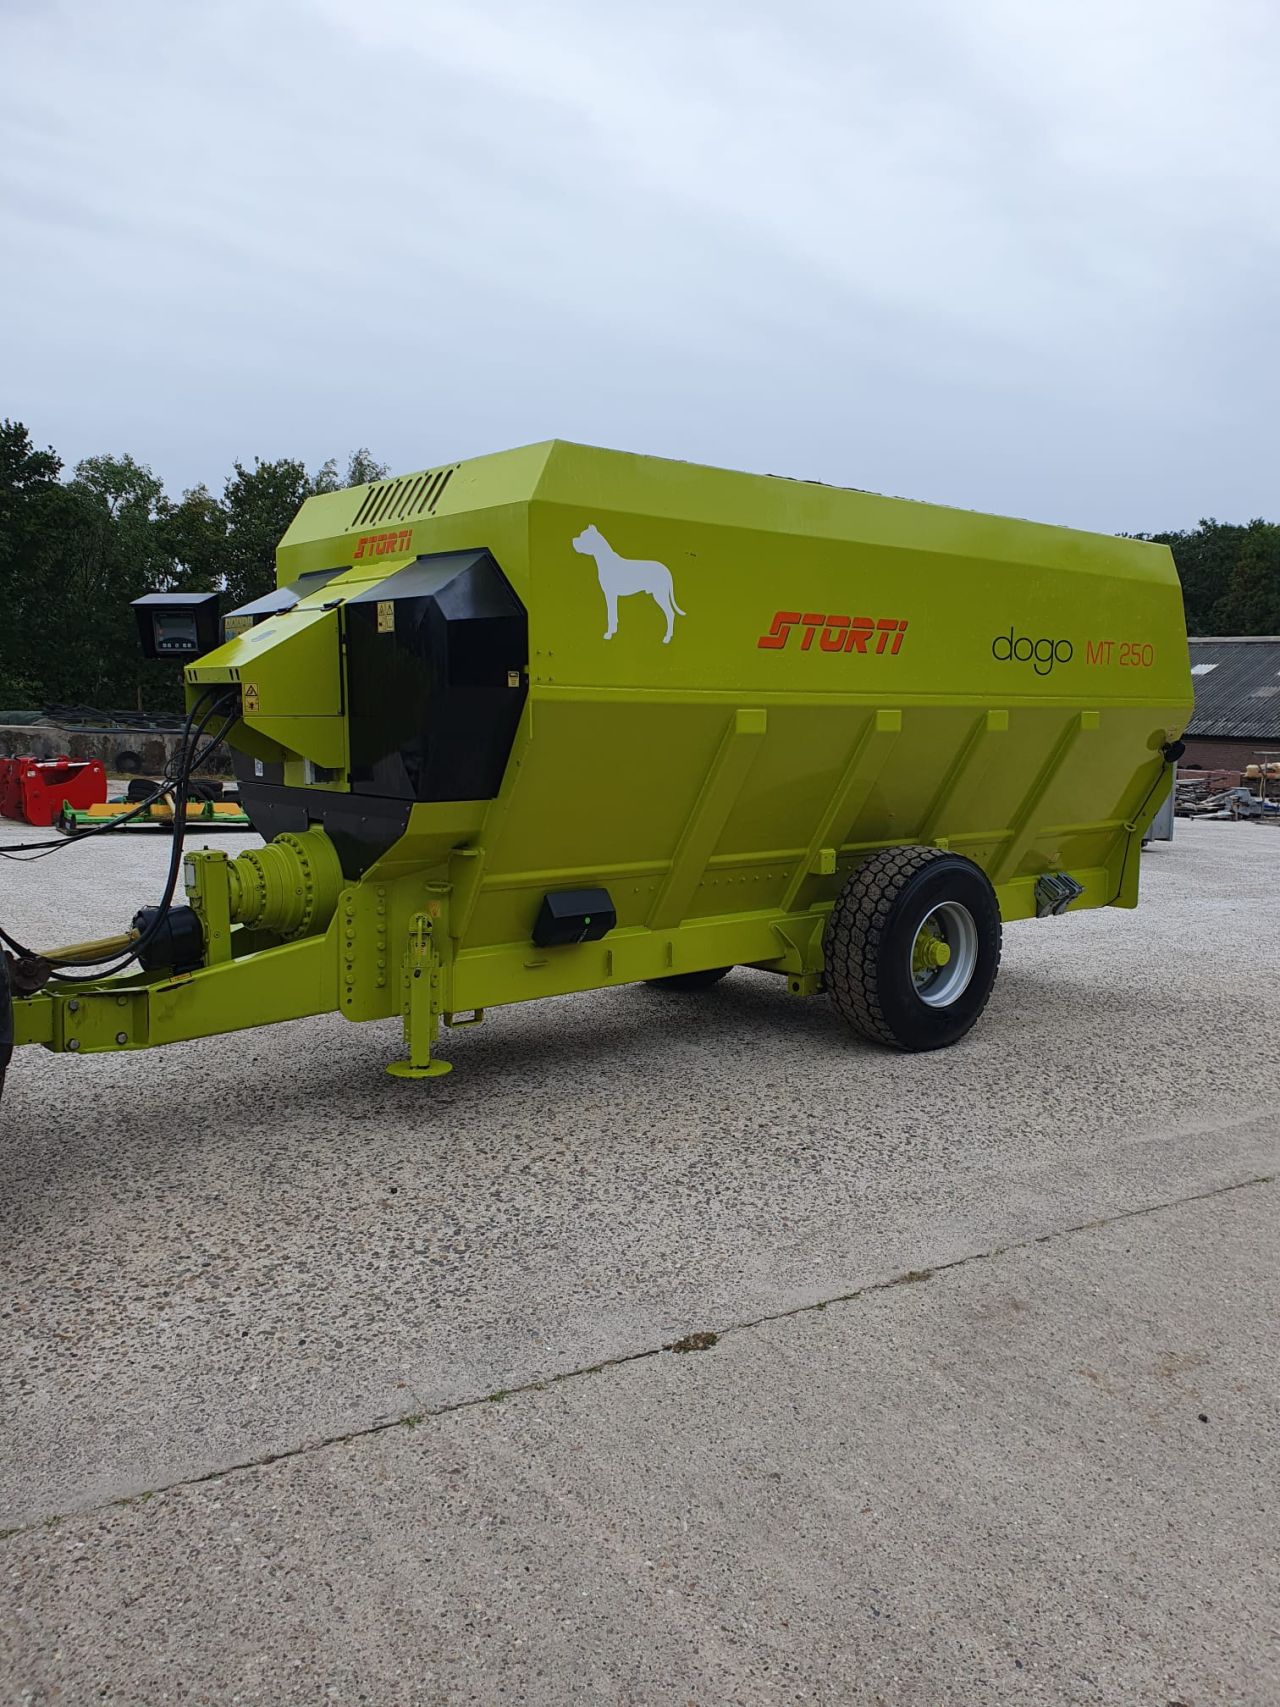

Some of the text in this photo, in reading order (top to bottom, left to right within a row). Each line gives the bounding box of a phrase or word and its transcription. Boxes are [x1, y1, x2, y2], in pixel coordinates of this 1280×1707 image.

[353, 529, 414, 558] STORTI
[757, 611, 908, 655] STORTI
[992, 626, 1154, 676] dogo MT 250
